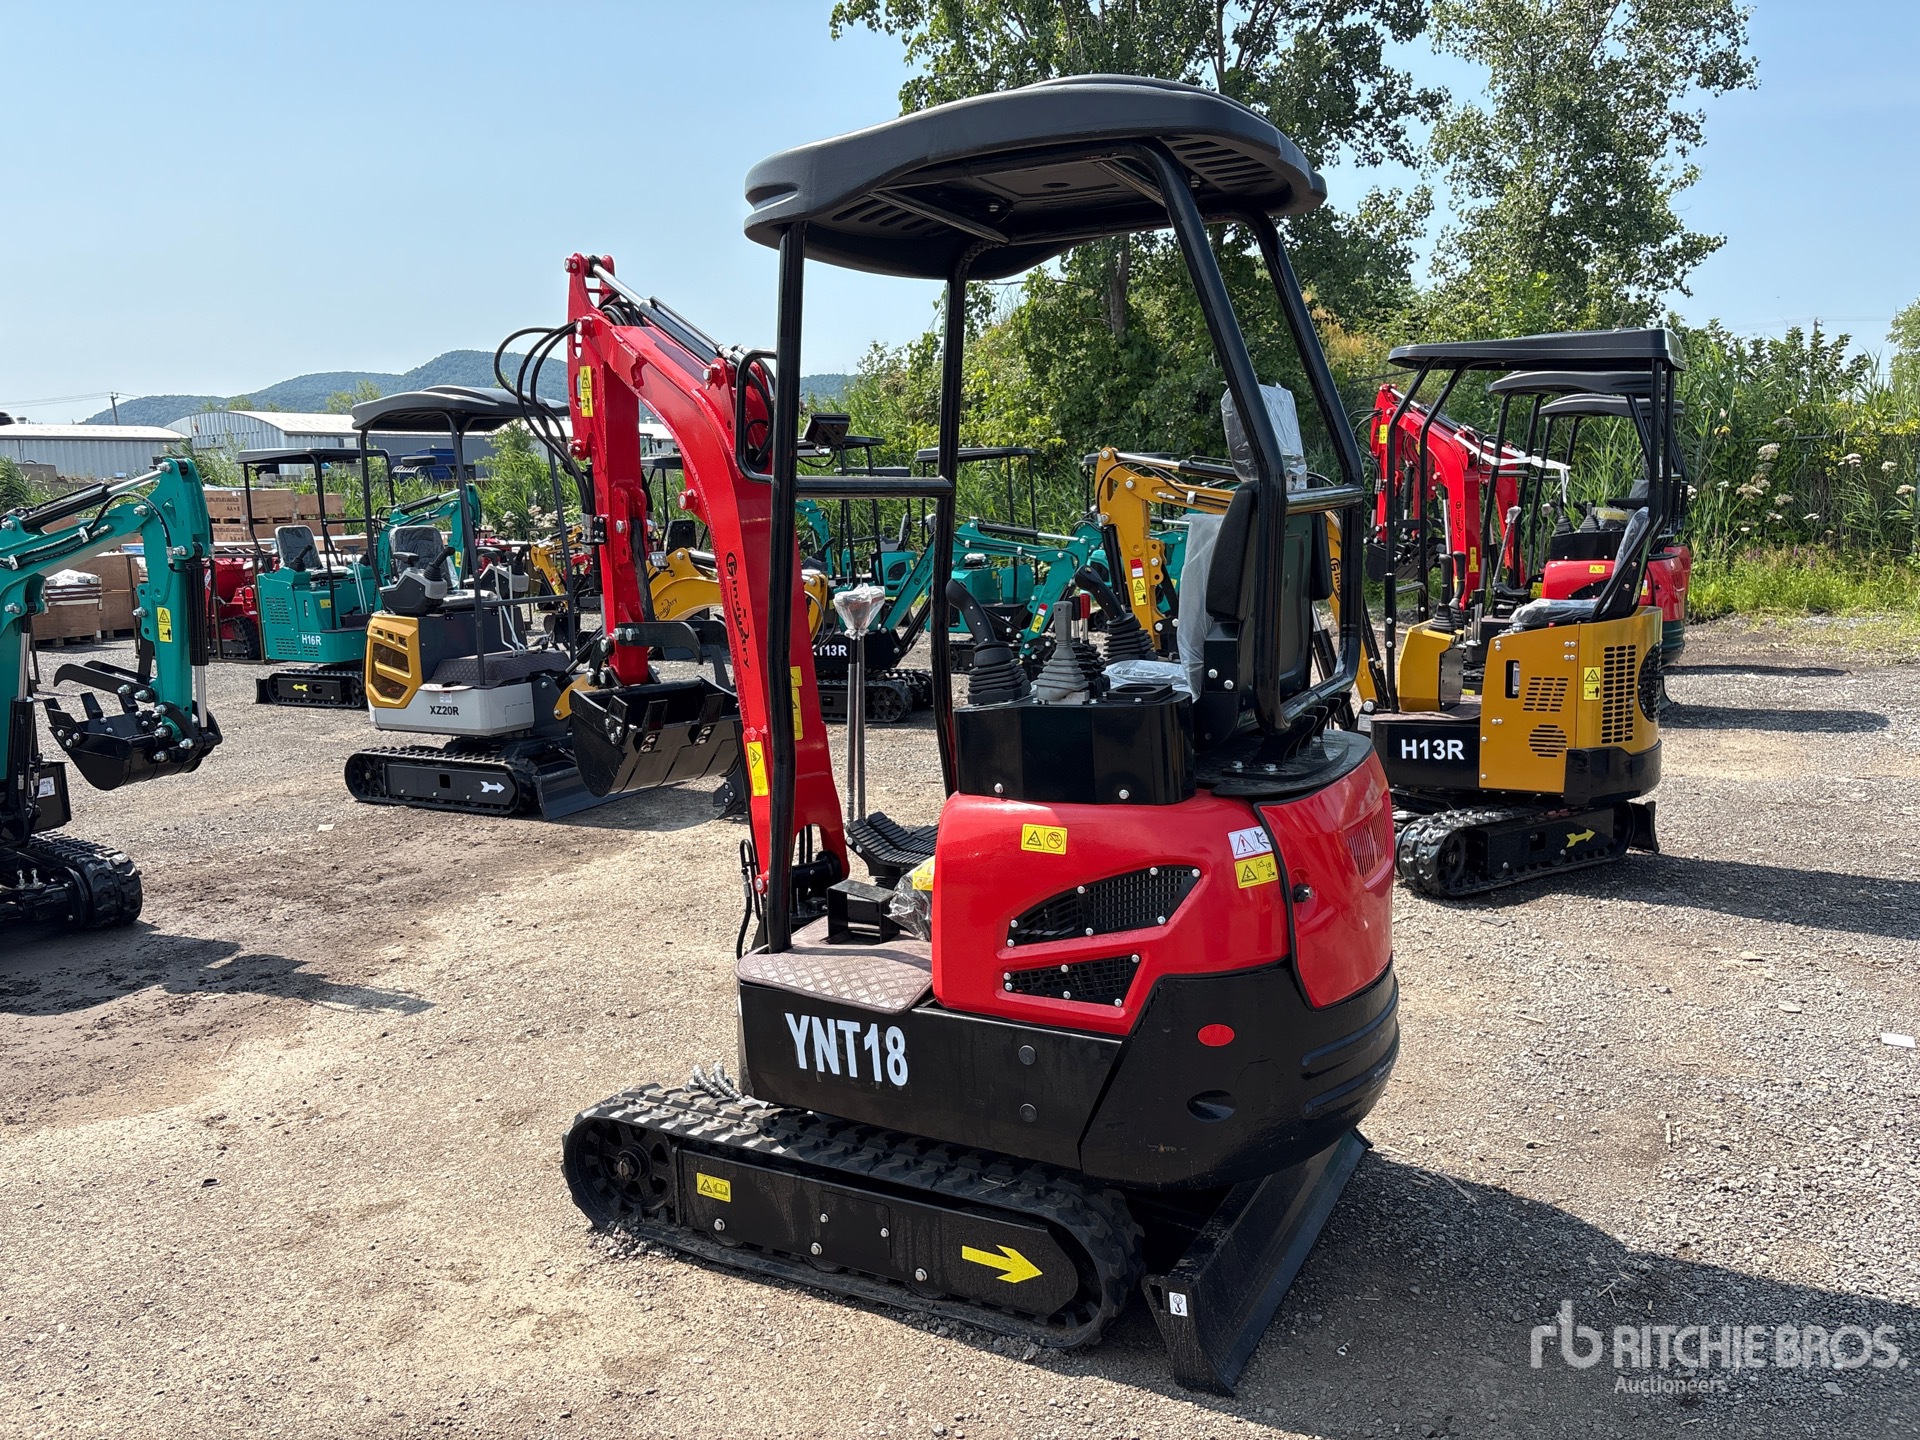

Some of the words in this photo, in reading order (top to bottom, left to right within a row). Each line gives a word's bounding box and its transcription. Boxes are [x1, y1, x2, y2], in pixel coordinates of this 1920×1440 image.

[301, 633, 322, 646] H16R
[429, 705, 460, 716] XZ20R
[1401, 738, 1465, 760] H13R
[784, 1012, 909, 1087] YNT18
